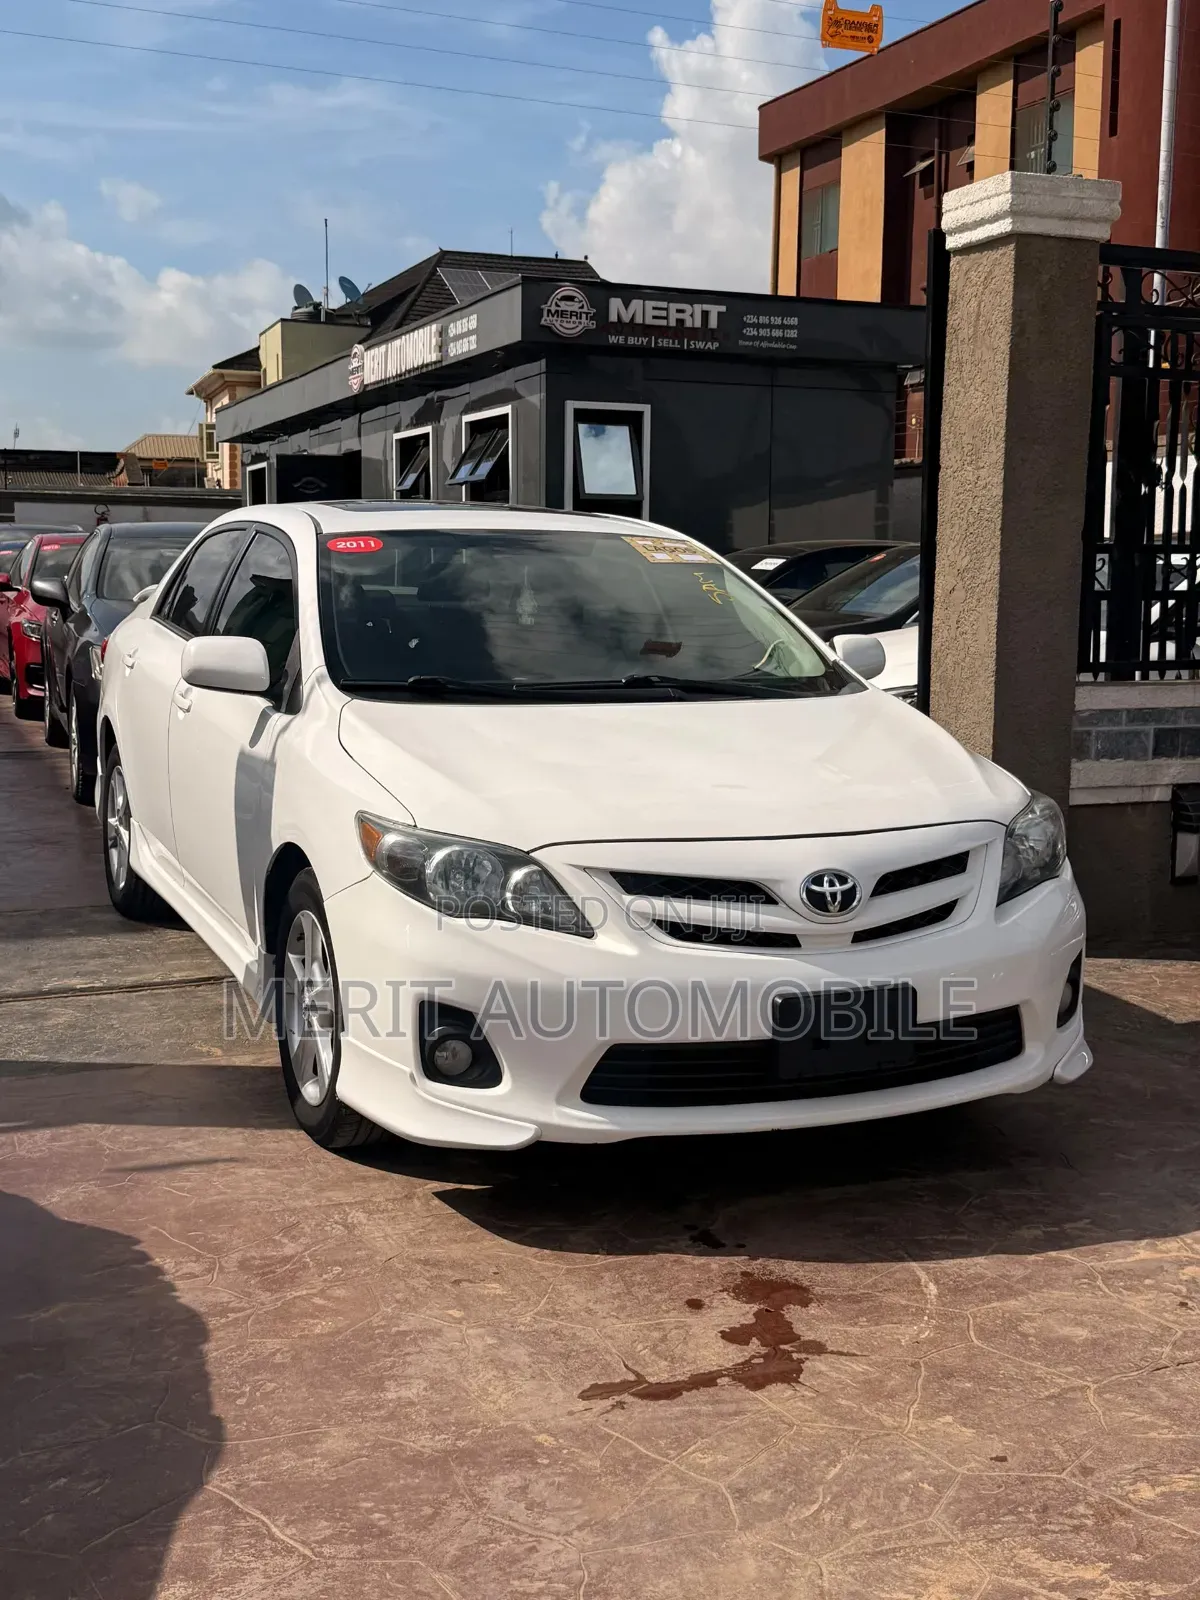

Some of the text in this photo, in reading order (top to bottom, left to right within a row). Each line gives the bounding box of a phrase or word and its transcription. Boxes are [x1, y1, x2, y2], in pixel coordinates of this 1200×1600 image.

[844, 19, 879, 28] DANGER
[546, 308, 592, 320] MERIT
[608, 297, 727, 329] MERIT
[608, 335, 720, 350] WE BUY SELL SWAP
[364, 344, 387, 385] MERIT
[387, 323, 441, 378] AUTOMOBILE
[336, 540, 375, 548] 2011
